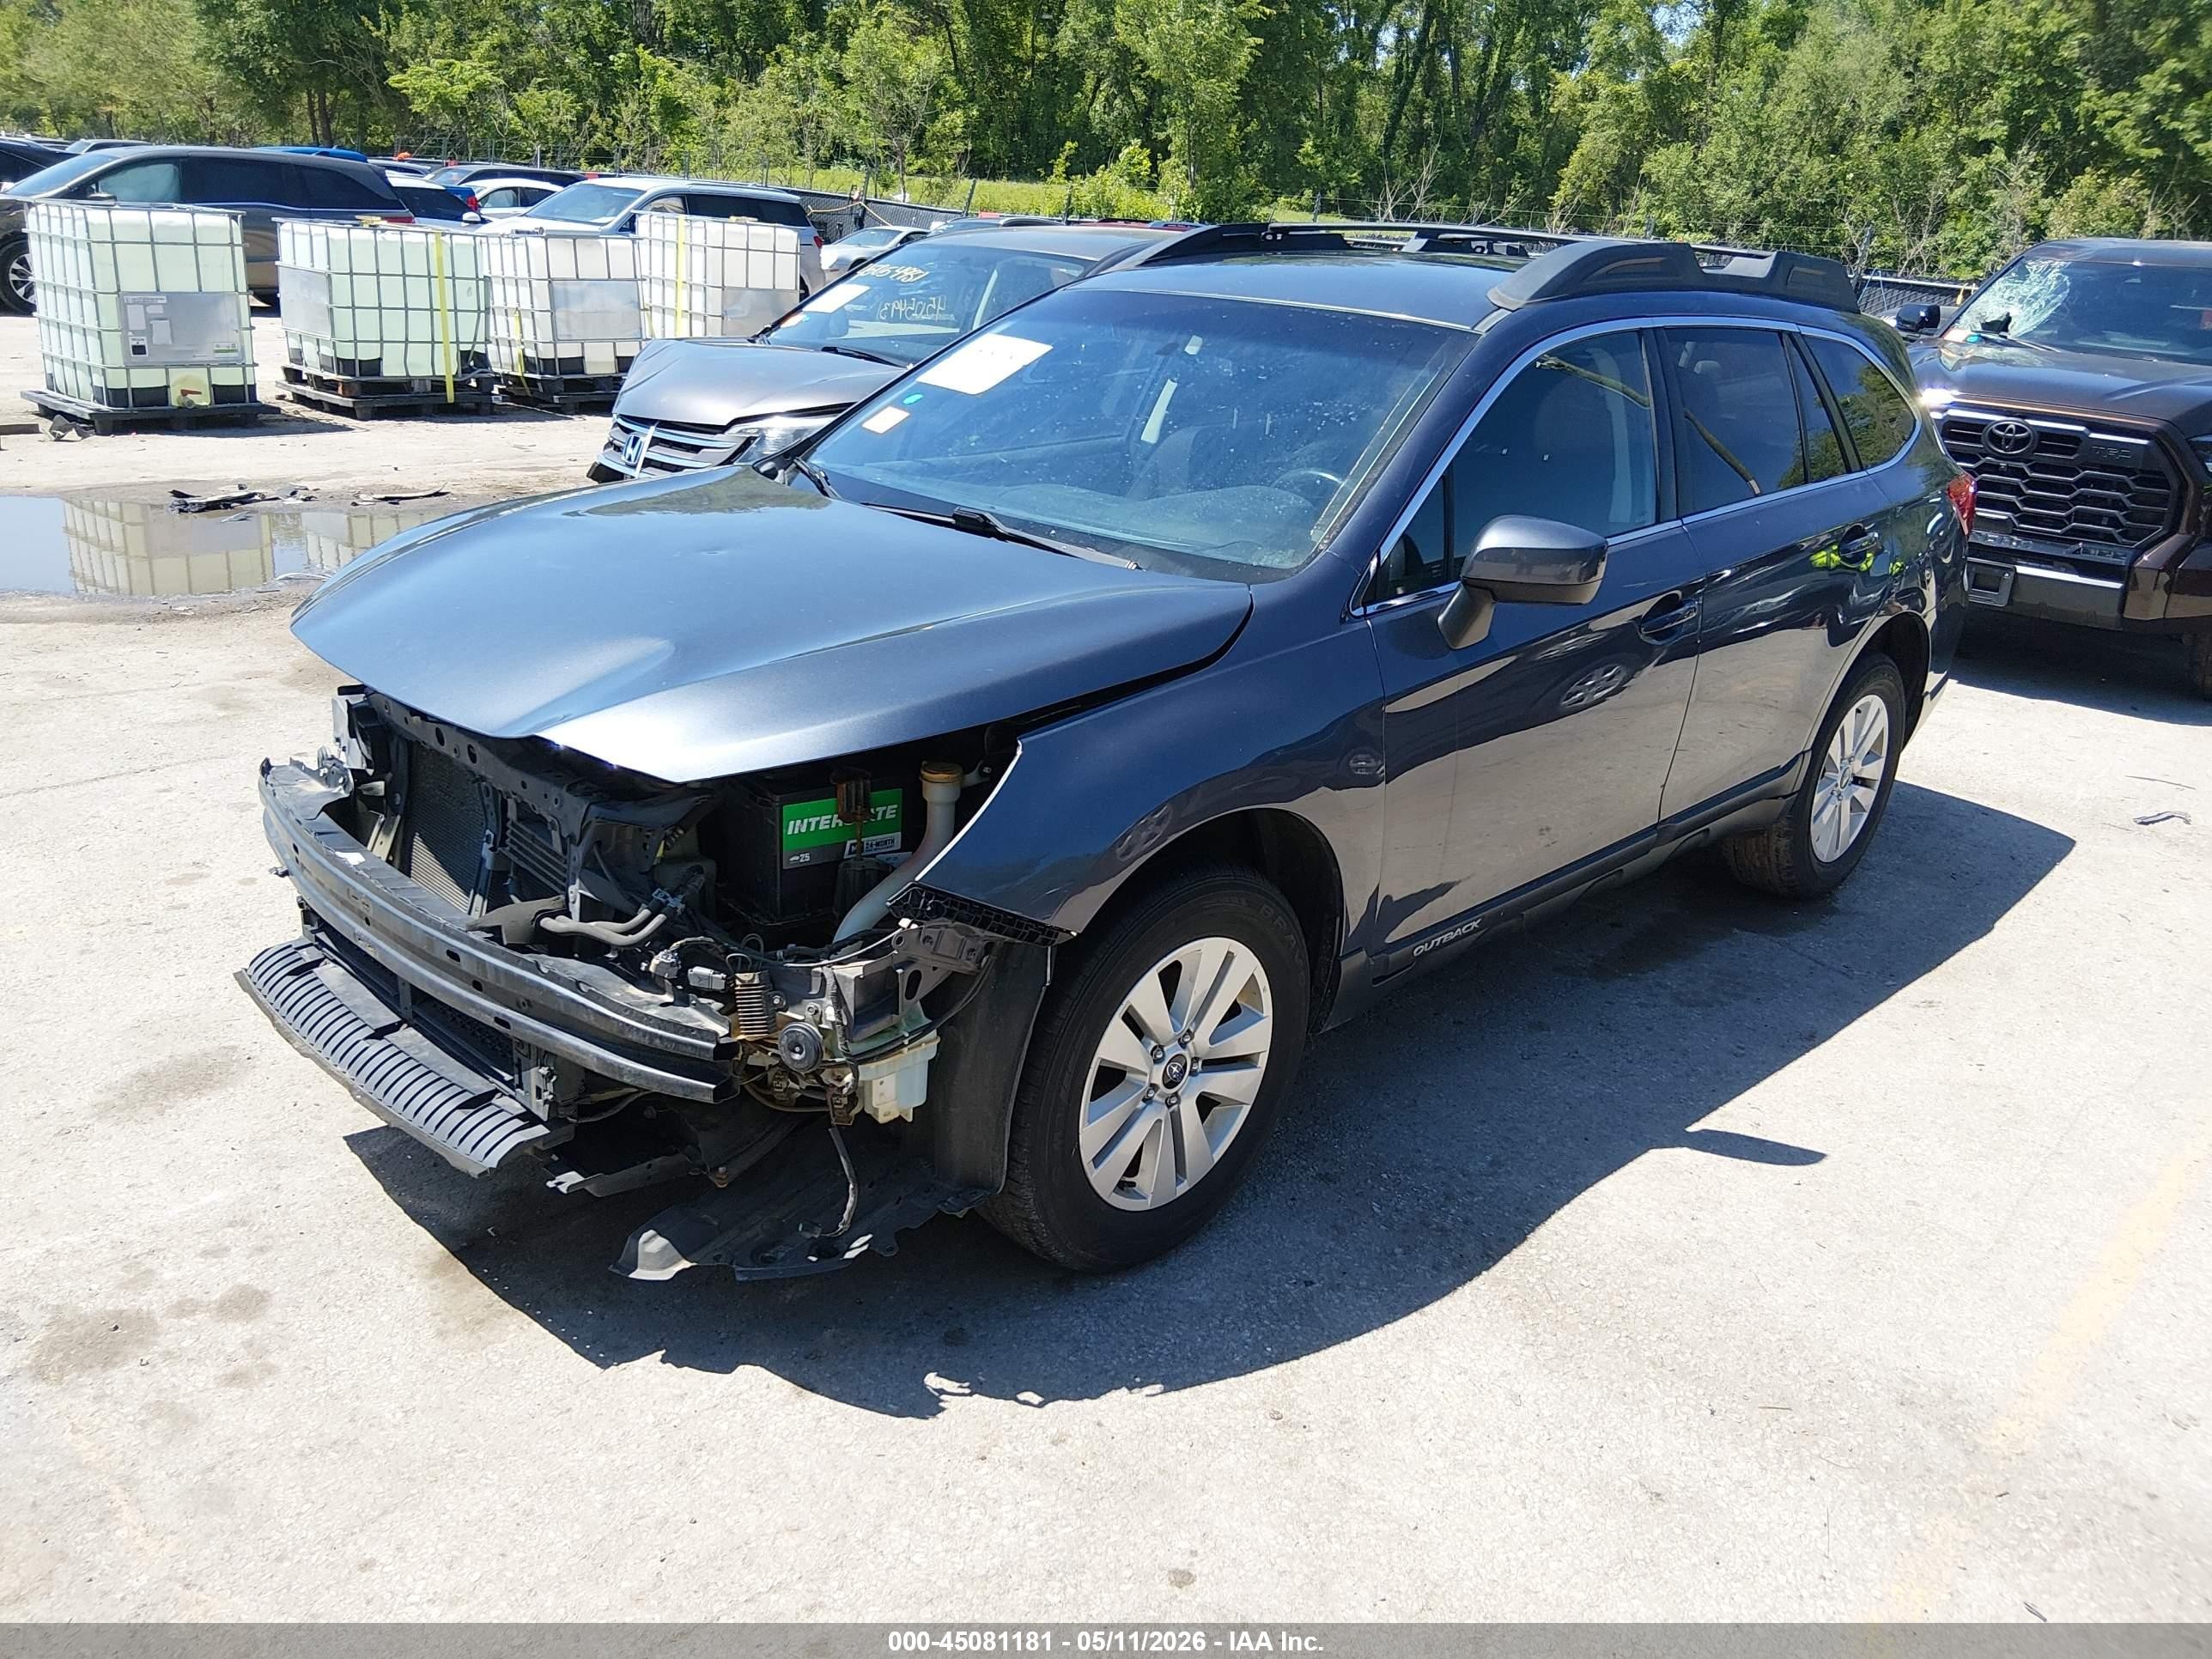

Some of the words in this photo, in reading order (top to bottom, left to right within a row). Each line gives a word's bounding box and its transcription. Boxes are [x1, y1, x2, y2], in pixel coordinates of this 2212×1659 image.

[787, 804, 898, 835] INTERTE
[799, 853, 811, 863] 25
[1413, 918, 1482, 957] OUTBACK
